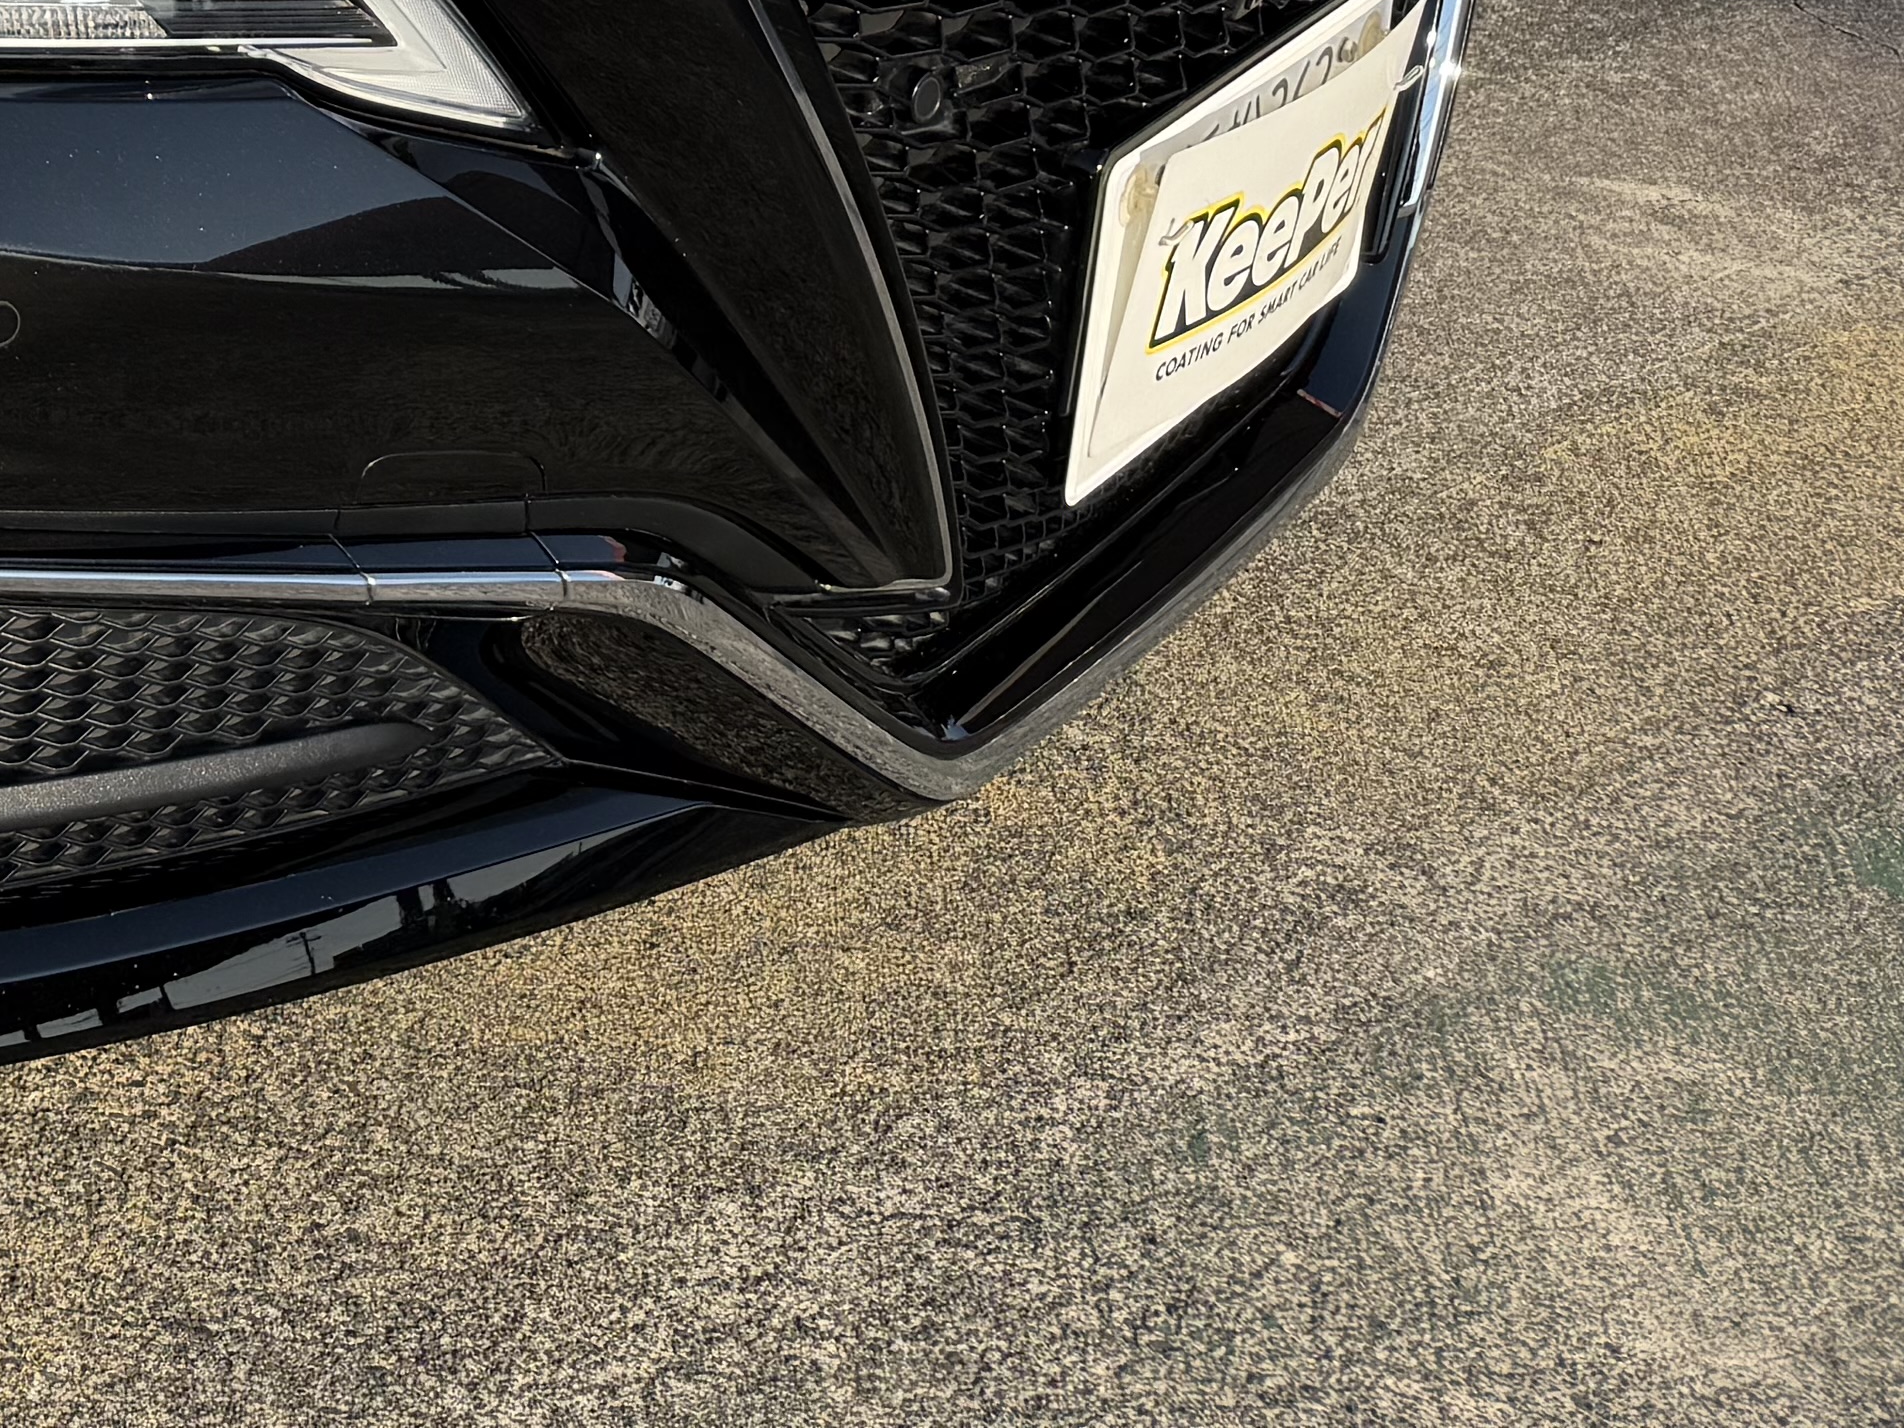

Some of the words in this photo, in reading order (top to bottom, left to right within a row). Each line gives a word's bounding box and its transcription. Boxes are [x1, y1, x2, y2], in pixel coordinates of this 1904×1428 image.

[1156, 332, 1223, 381] COATING
[1227, 315, 1254, 344] FOR
[1258, 280, 1297, 324] SMART
[1298, 261, 1320, 291] CAR
